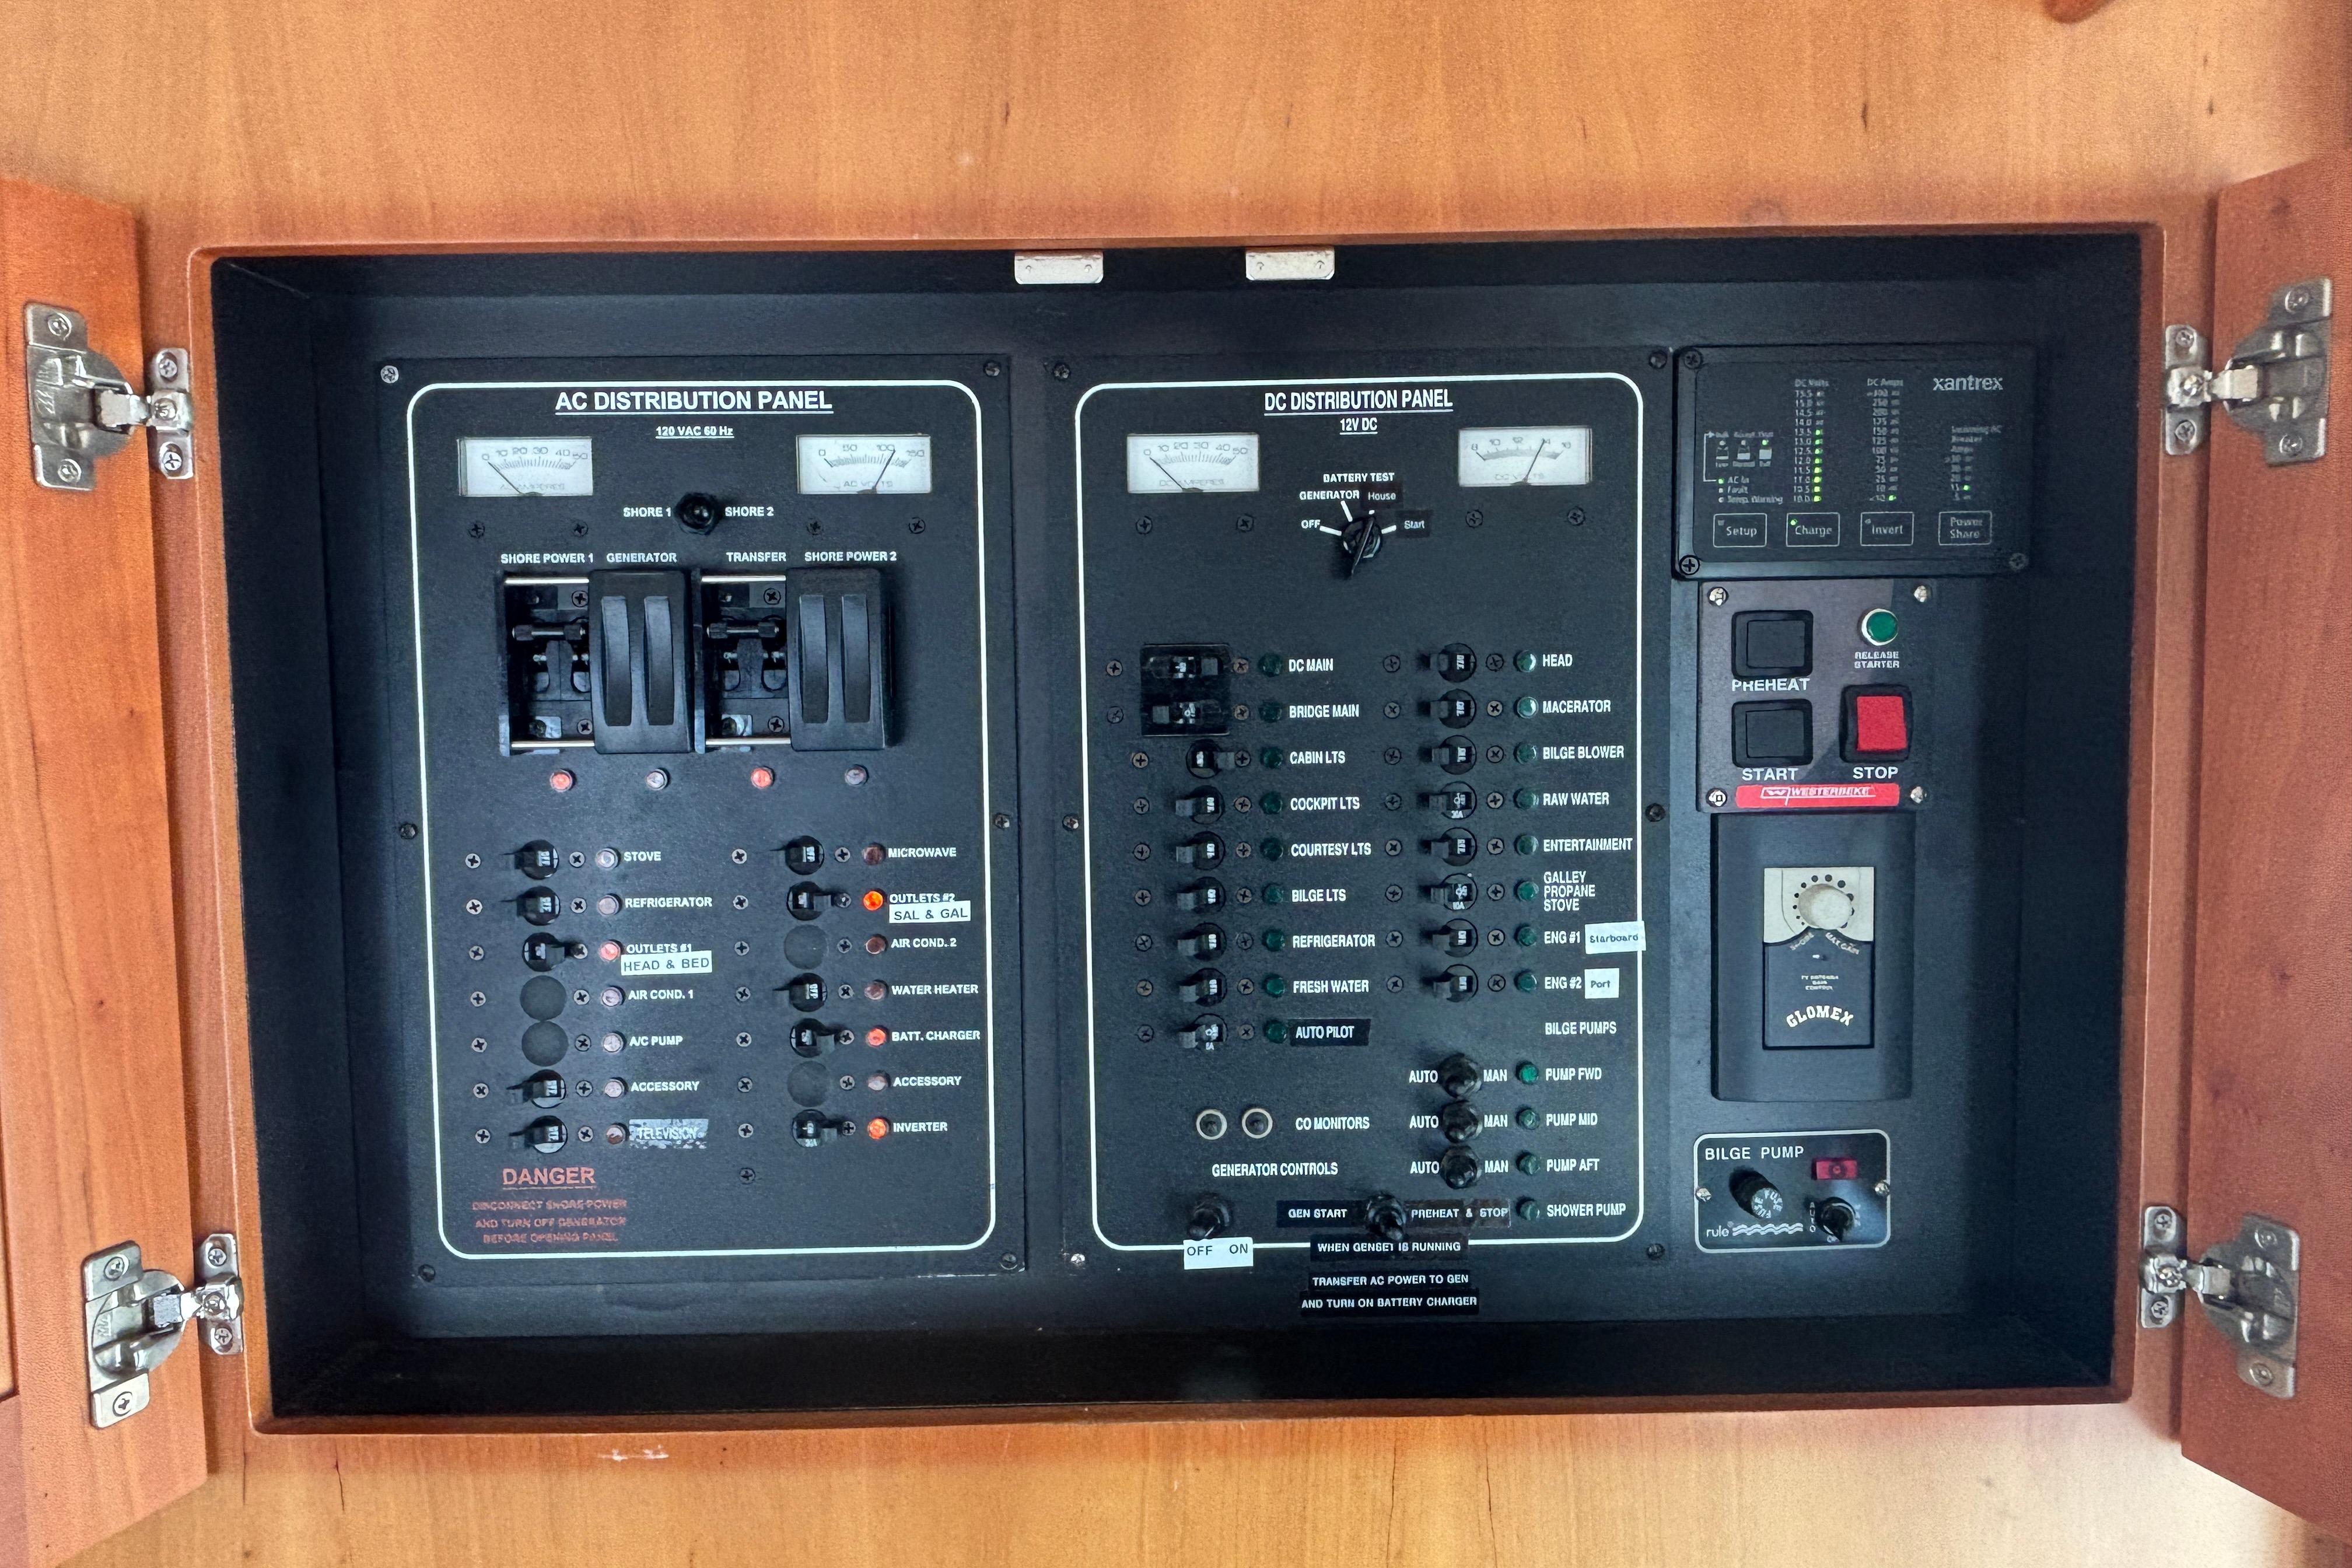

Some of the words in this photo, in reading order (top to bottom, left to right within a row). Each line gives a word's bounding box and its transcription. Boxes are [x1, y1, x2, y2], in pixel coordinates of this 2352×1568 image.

[1933, 375, 2003, 390] xantrex
[555, 392, 587, 410] AC
[594, 391, 751, 410] DISTRIBUTION
[758, 391, 832, 409] PANEL
[1265, 393, 1286, 411] DC
[1291, 390, 1397, 410] DISTRIBUTION
[1402, 389, 1452, 407] PANEL
[1340, 418, 1359, 430] 12V
[1362, 418, 1377, 430] DC
[656, 426, 675, 436] 120
[677, 426, 701, 436] VAC
[704, 426, 716, 436] 60
[719, 426, 733, 435] Hz
[1324, 473, 1367, 482] BATTERY
[1370, 473, 1394, 481] TEST
[1300, 490, 1359, 500] GENERATOR
[624, 508, 663, 517] SHORE
[666, 508, 671, 517] 1
[726, 506, 764, 516] SHORE
[766, 506, 774, 516] 2
[1301, 520, 1320, 528] OFF
[1951, 517, 1982, 526] Power
[1727, 527, 1756, 537] Setup
[1796, 525, 1832, 537] Charge
[1873, 525, 1902, 534] Invert
[1950, 529, 1979, 538] Share
[501, 554, 540, 564] SHORE
[543, 554, 585, 563] POWER
[589, 553, 593, 562] 1
[607, 552, 677, 562] GENERATOR
[726, 552, 786, 562] TRANSFER
[805, 552, 843, 561] SHORE
[846, 551, 887, 561] POWER
[890, 551, 897, 561] 2
[1289, 659, 1304, 672] DC
[1307, 659, 1333, 671] MAIN
[1543, 654, 1572, 667] HEAD
[1732, 678, 1810, 691] PREHEAT
[1290, 705, 1329, 718] BRIDGE
[1333, 704, 1359, 717] MAIN
[1543, 700, 1611, 713] MACERATOR
[1290, 751, 1322, 764] CABIN
[1326, 751, 1345, 764] LTS
[1544, 747, 1575, 760] BILGE
[1578, 746, 1624, 758] BLOWER
[1742, 768, 1798, 780] START
[1853, 766, 1898, 779] STOP
[1291, 797, 1338, 810] COCKPIT
[1340, 797, 1360, 809] LTS
[1544, 793, 1568, 806] RAW
[1571, 792, 1609, 805] WATER
[1292, 843, 1349, 856] COURTESY
[1352, 842, 1371, 855] LTS
[1544, 838, 1633, 852] ENTERTAINMENT
[624, 852, 661, 862] STOVE
[888, 848, 956, 858] MICROWAVE
[1544, 871, 1586, 884] GALLEY
[1292, 890, 1324, 902] BILGE
[1326, 889, 1346, 901] LTS
[1544, 884, 1595, 897] PROPANE
[625, 897, 712, 908] REFRIGERATOR
[890, 893, 940, 903] OUTLETS
[1544, 899, 1580, 911] STOVE
[894, 911, 919, 920] SAL
[926, 910, 934, 919] &
[941, 908, 968, 918] GAL
[891, 939, 911, 948] AIR
[913, 938, 949, 947] COND.
[950, 938, 957, 947] 2
[1293, 935, 1375, 948] REFRIGERATOR
[1545, 931, 1567, 944] ENG
[1569, 931, 1580, 943] #1
[1590, 935, 1638, 943] Starboard
[626, 944, 677, 953] OUTLETS
[624, 961, 659, 971] HEAD
[666, 960, 674, 969] &
[682, 958, 709, 968] BED
[1293, 981, 1328, 993] FRESH
[1331, 980, 1368, 992] WATER
[1545, 977, 1567, 989] ENG
[1570, 977, 1581, 989] #2
[628, 990, 648, 999] AIR
[650, 989, 685, 999] COND.
[688, 989, 694, 999] 1
[892, 985, 932, 995] WATER
[935, 985, 978, 994] HEATER
[1787, 1006, 1853, 1027] GLOMEX
[1296, 1026, 1324, 1038] AUTO
[1326, 1026, 1354, 1038] PILOT
[1545, 1022, 1577, 1035] BILGE
[1580, 1021, 1616, 1034] PUMPS
[629, 1036, 649, 1046] A/C
[651, 1036, 683, 1045] PUMP
[892, 1031, 923, 1041] BATT.
[926, 1031, 980, 1041] CHARGER
[1409, 1070, 1437, 1083] AUTO
[1484, 1069, 1507, 1082] MAN
[1546, 1068, 1576, 1080] PUMP
[1578, 1068, 1602, 1080] FWD
[631, 1081, 699, 1091] ACCESSORY
[893, 1076, 961, 1086] ACCESSORY
[1296, 1118, 1311, 1130] CO
[1314, 1116, 1370, 1129] MONITORS
[1409, 1115, 1438, 1129] AUTO
[1485, 1114, 1507, 1127] MAN
[1546, 1113, 1576, 1126] PUMP
[1578, 1113, 1598, 1125] MID
[894, 1122, 947, 1132] INVERTER
[1706, 1147, 1751, 1160] BILGE
[1761, 1146, 1804, 1158] PUMP
[1212, 1163, 1278, 1177] GENERATOR
[1280, 1162, 1338, 1175] CONTROLS
[1410, 1161, 1439, 1174] AUTO
[1485, 1160, 1508, 1172] MAN
[1547, 1159, 1576, 1171] PUMP
[1579, 1158, 1600, 1171] AFT
[503, 1167, 595, 1185] DANGER
[1289, 1209, 1310, 1218] GEN
[1314, 1209, 1347, 1218] START
[1412, 1209, 1459, 1218] PREHEAT
[1480, 1208, 1509, 1218] STOP
[1547, 1204, 1593, 1217] SHOWER
[1596, 1203, 1626, 1216] PUMP
[1707, 1226, 1729, 1237] rule
[1187, 1245, 1212, 1255] OFF
[1230, 1244, 1248, 1254] ON
[1318, 1243, 1349, 1252] WHEN
[1353, 1242, 1393, 1251] GENSET
[1399, 1242, 1408, 1251] IS
[1412, 1242, 1461, 1251] RUNNING
[1312, 1276, 1367, 1286] TRANSFER
[1370, 1276, 1384, 1285] AC
[1388, 1275, 1426, 1284] POWER
[1429, 1275, 1443, 1283] TO
[1447, 1275, 1468, 1283] GEN
[1302, 1300, 1323, 1308] AND
[1326, 1299, 1354, 1308] TURN
[1358, 1298, 1373, 1307] ON
[1378, 1298, 1422, 1307] BATTERY
[1427, 1297, 1476, 1306] CHARGER
